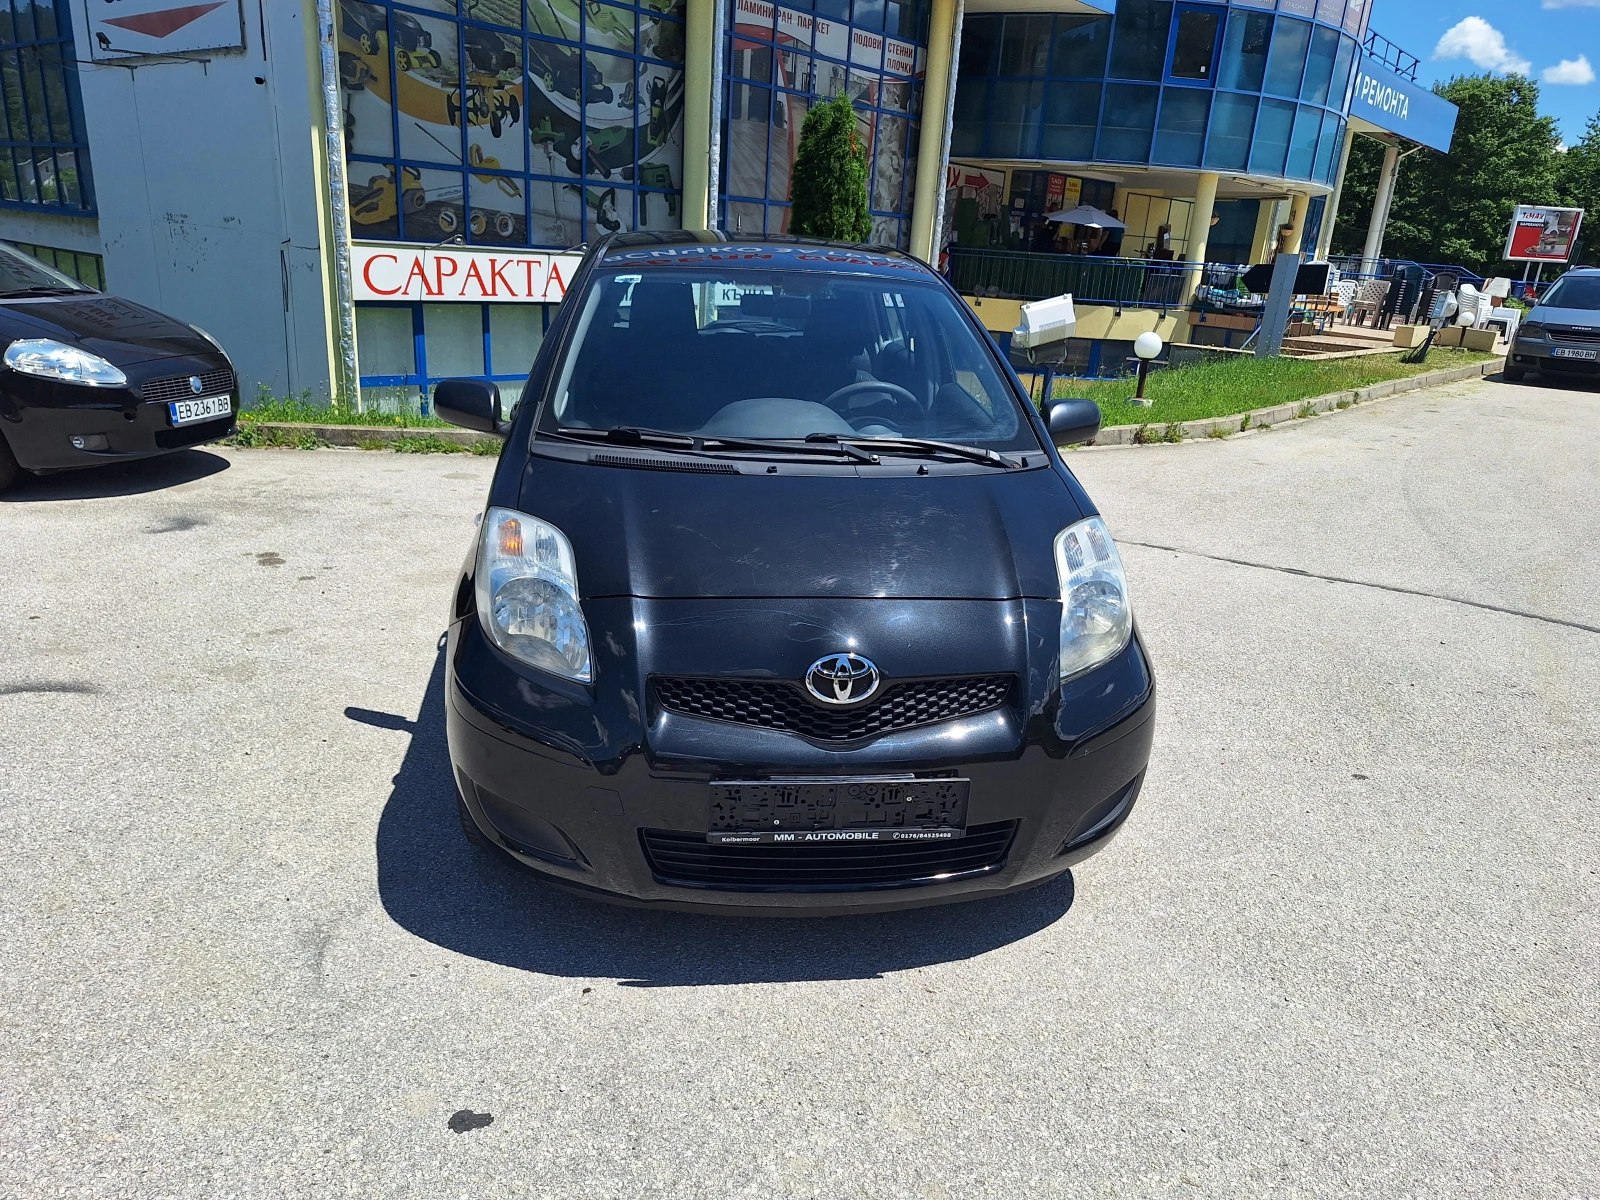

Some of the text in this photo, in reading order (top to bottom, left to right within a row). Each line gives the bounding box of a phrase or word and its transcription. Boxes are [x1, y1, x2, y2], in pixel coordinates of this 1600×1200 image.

[737, 0, 830, 35] ЛАМИНИРАН ПАРКЕТ
[853, 32, 913, 59] ПОДОВИ СТЕННИ
[886, 57, 913, 74] ПЛОЧКИ
[1360, 75, 1409, 120] РЕМОНТА
[362, 253, 567, 298] САРАКТА
[1555, 348, 1596, 359] EB 1980 BH
[178, 397, 229, 420] EB 2361 BB
[773, 833, 795, 841] MM
[804, 832, 880, 841] AUTOMOBILE
